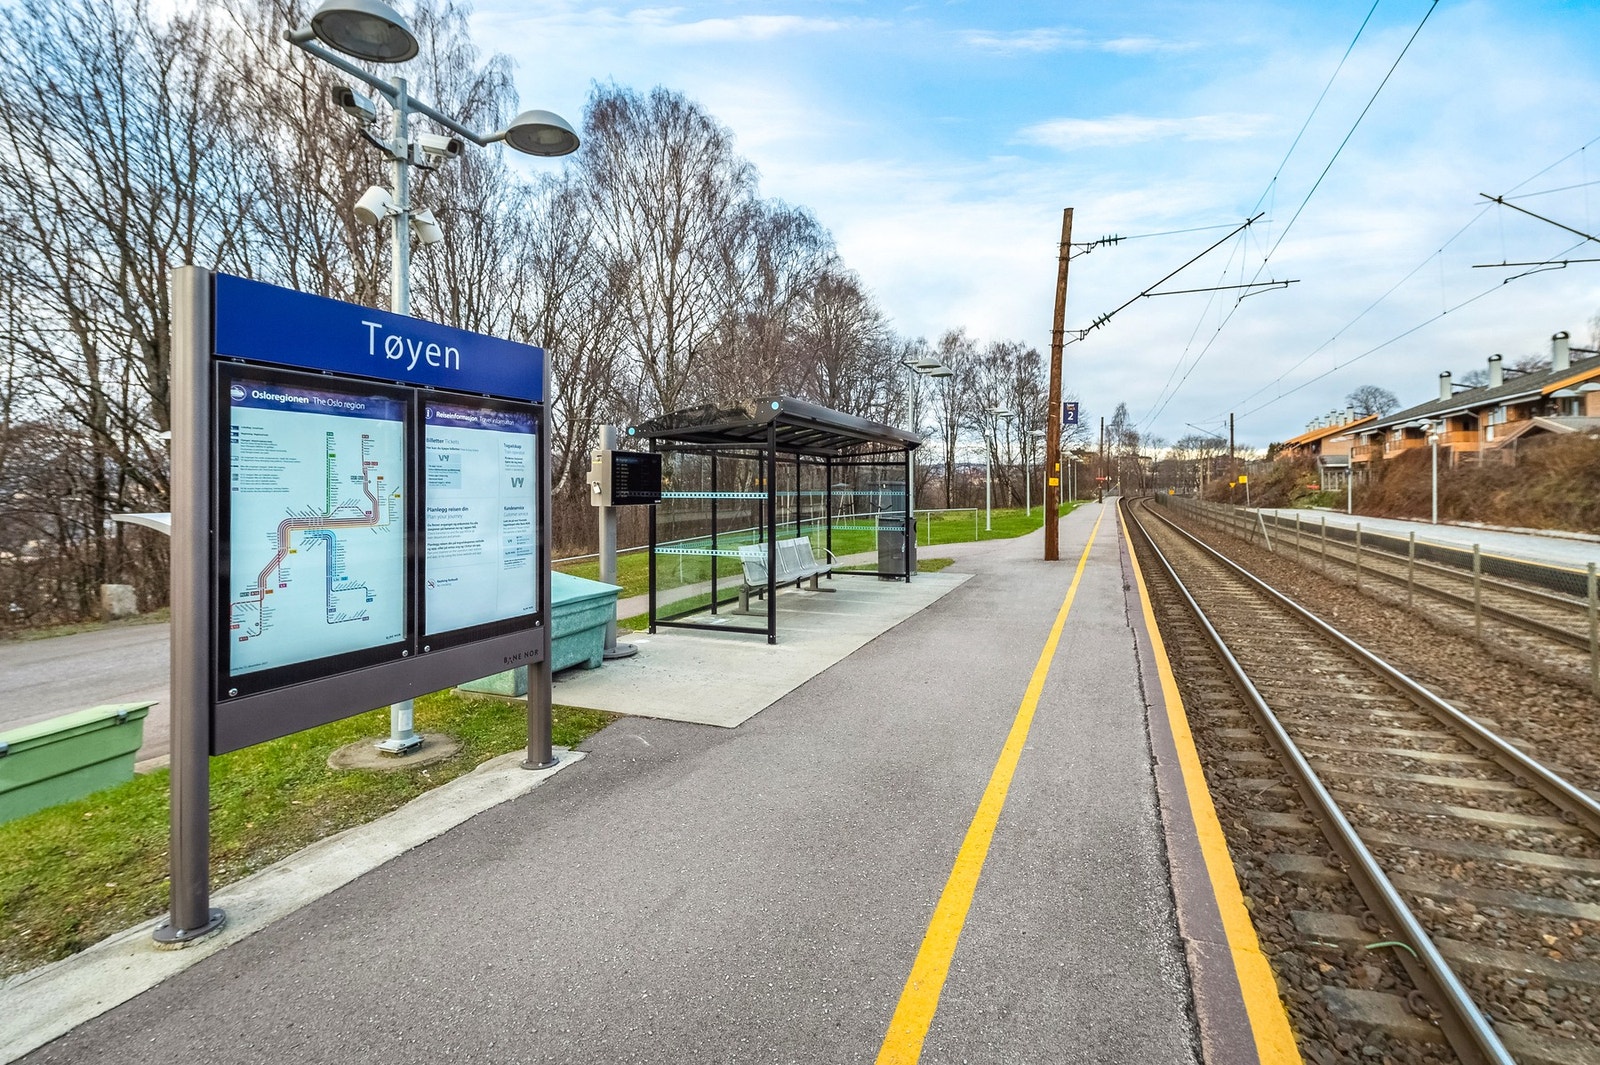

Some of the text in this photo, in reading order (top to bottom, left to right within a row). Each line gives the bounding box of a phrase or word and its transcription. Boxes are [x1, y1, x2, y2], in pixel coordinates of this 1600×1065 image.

[361, 320, 460, 371] Tøyen
[251, 390, 366, 411] Osloregionen The Oslo region
[435, 411, 478, 422] Reiseinformasjon
[1067, 411, 1074, 420] 2
[503, 649, 539, 665] BANE NOR
